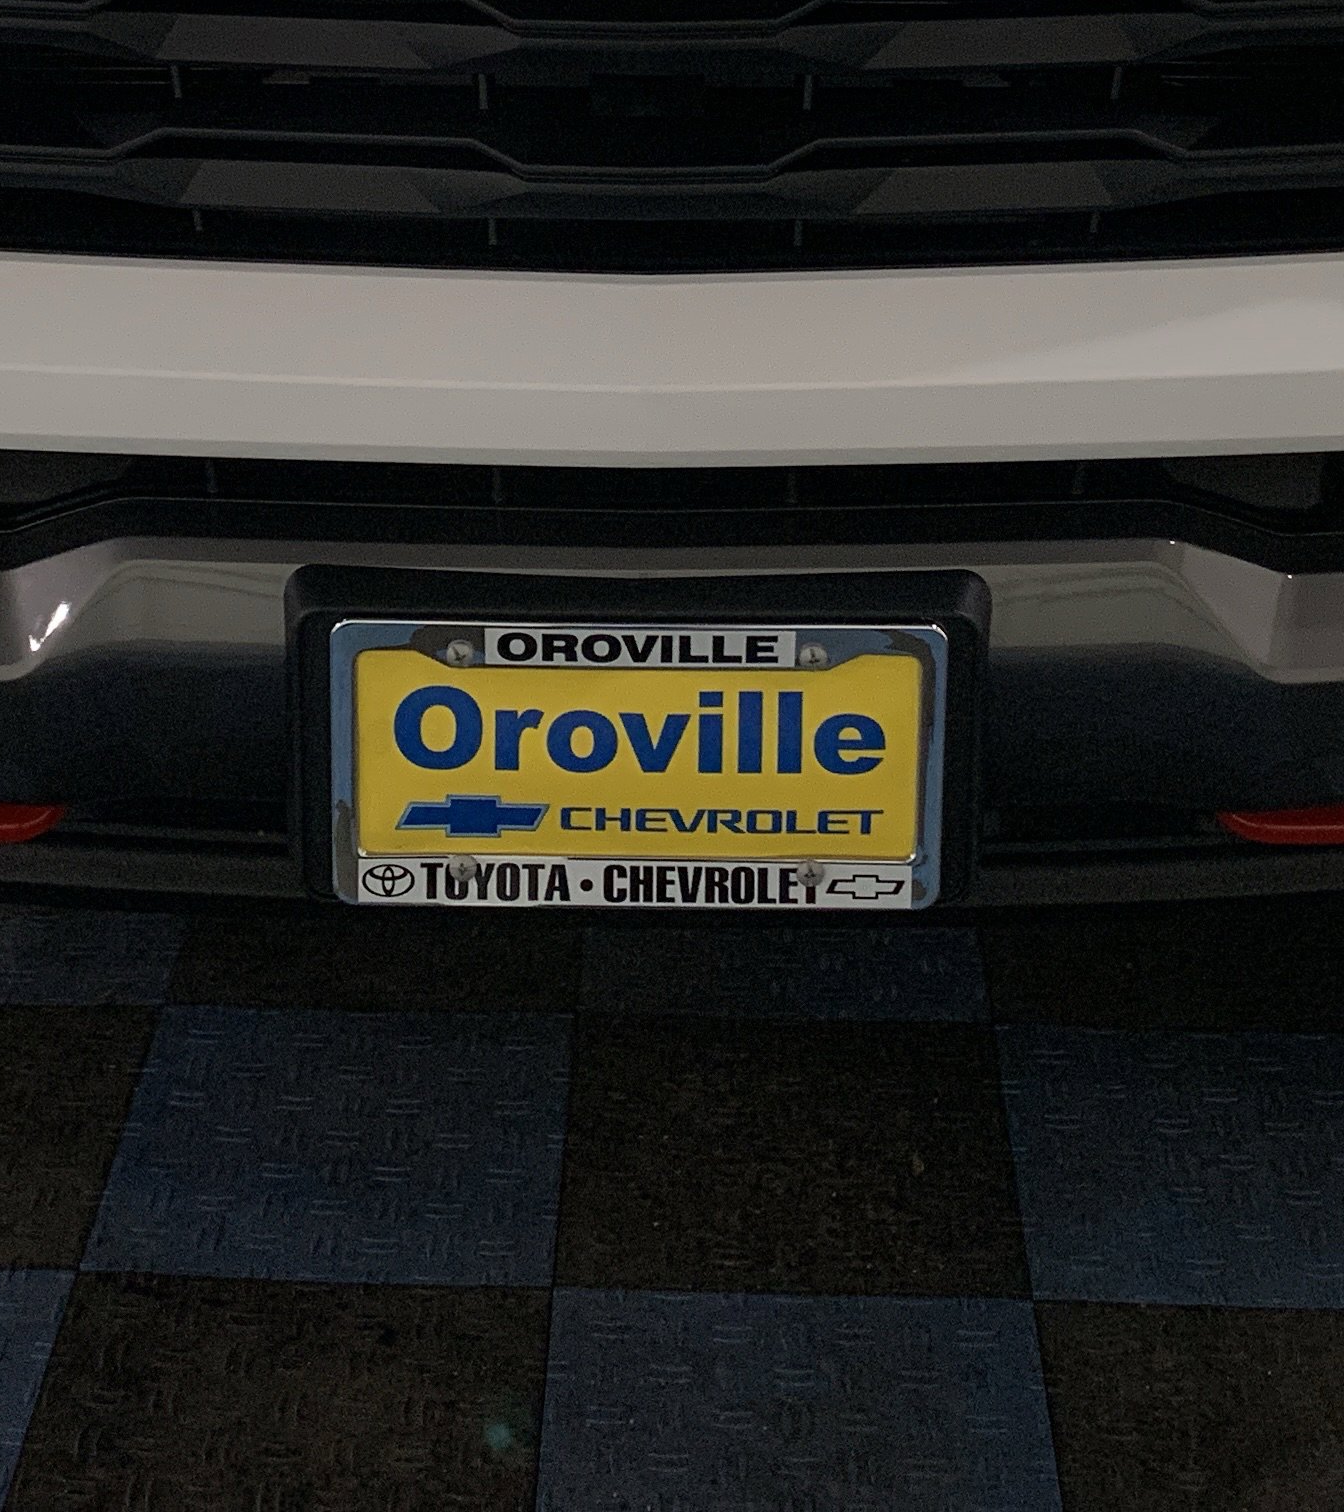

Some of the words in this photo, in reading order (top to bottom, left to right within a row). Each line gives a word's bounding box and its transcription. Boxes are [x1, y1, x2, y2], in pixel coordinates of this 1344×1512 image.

[496, 632, 779, 664] OROVILLE
[393, 685, 887, 776] Oroville
[559, 807, 885, 835] CHEVROLET
